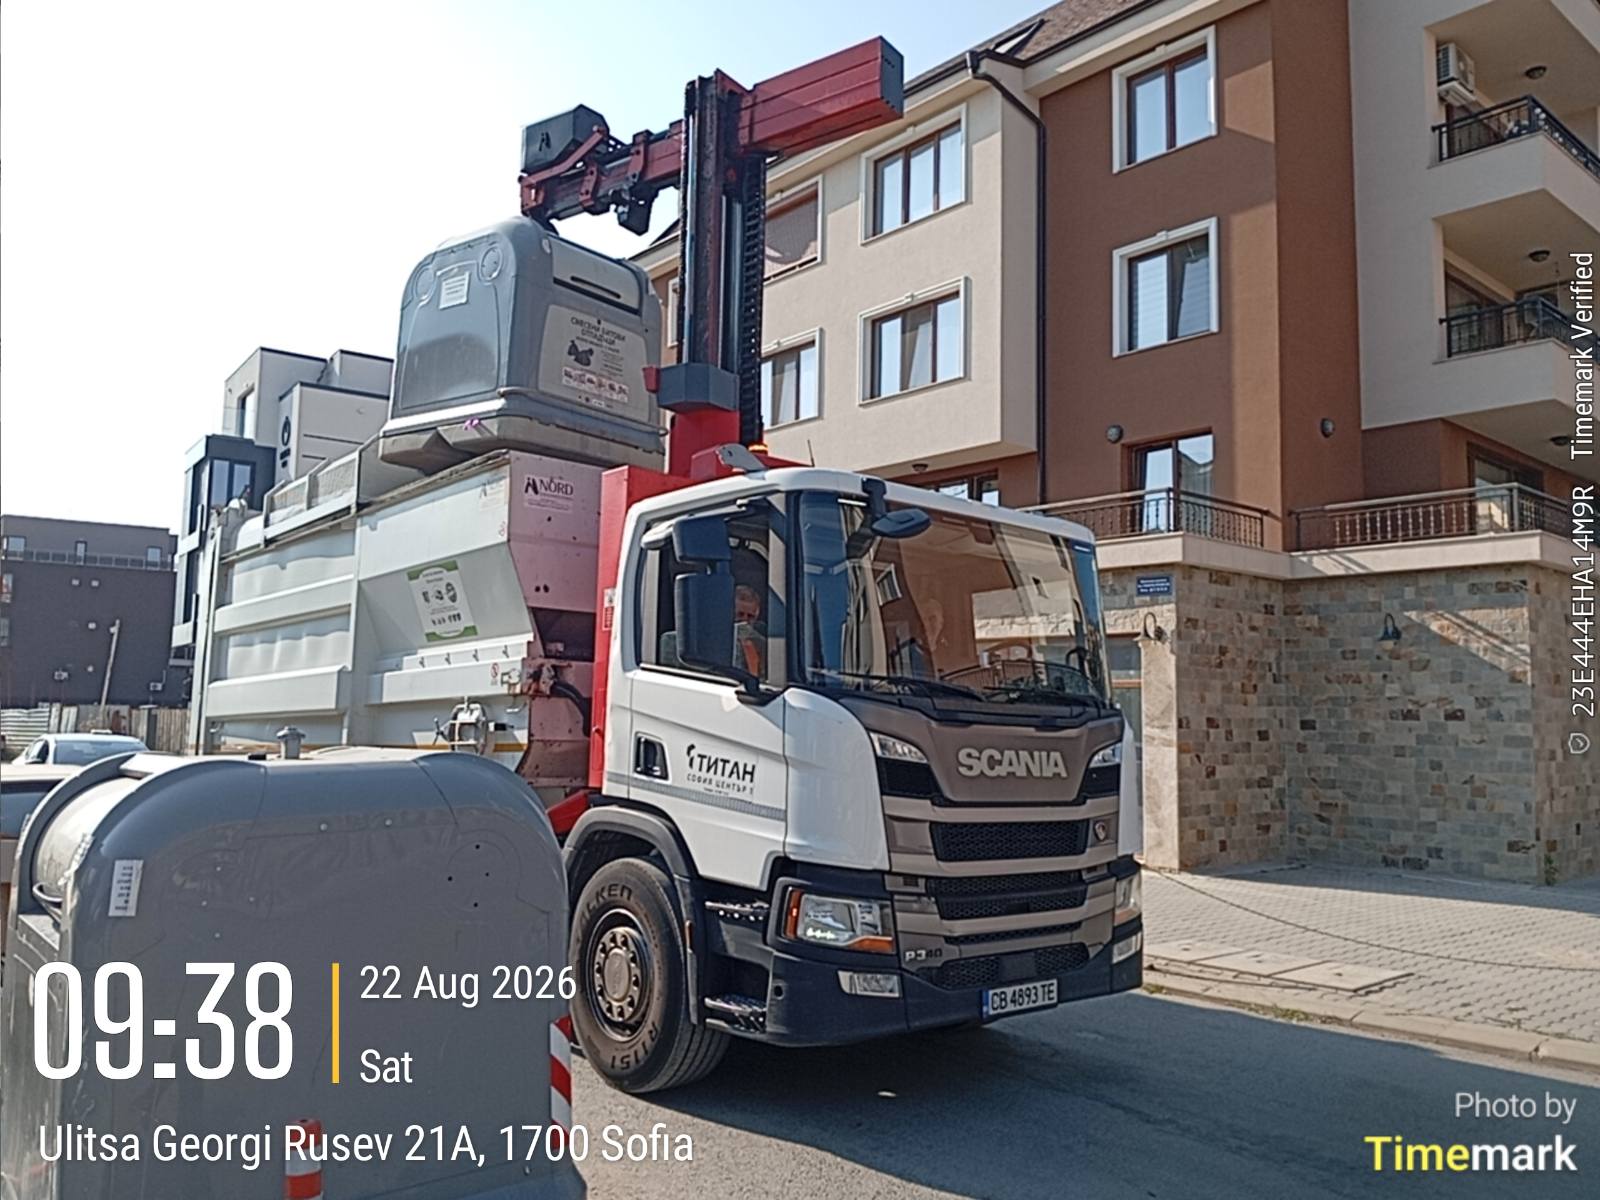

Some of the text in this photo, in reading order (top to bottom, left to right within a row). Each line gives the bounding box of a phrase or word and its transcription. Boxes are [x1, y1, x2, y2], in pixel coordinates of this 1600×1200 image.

[697, 753, 756, 783] ТИТАН
[957, 747, 1068, 777] SCANIA
[991, 982, 1055, 1011] CB 4893 TE
